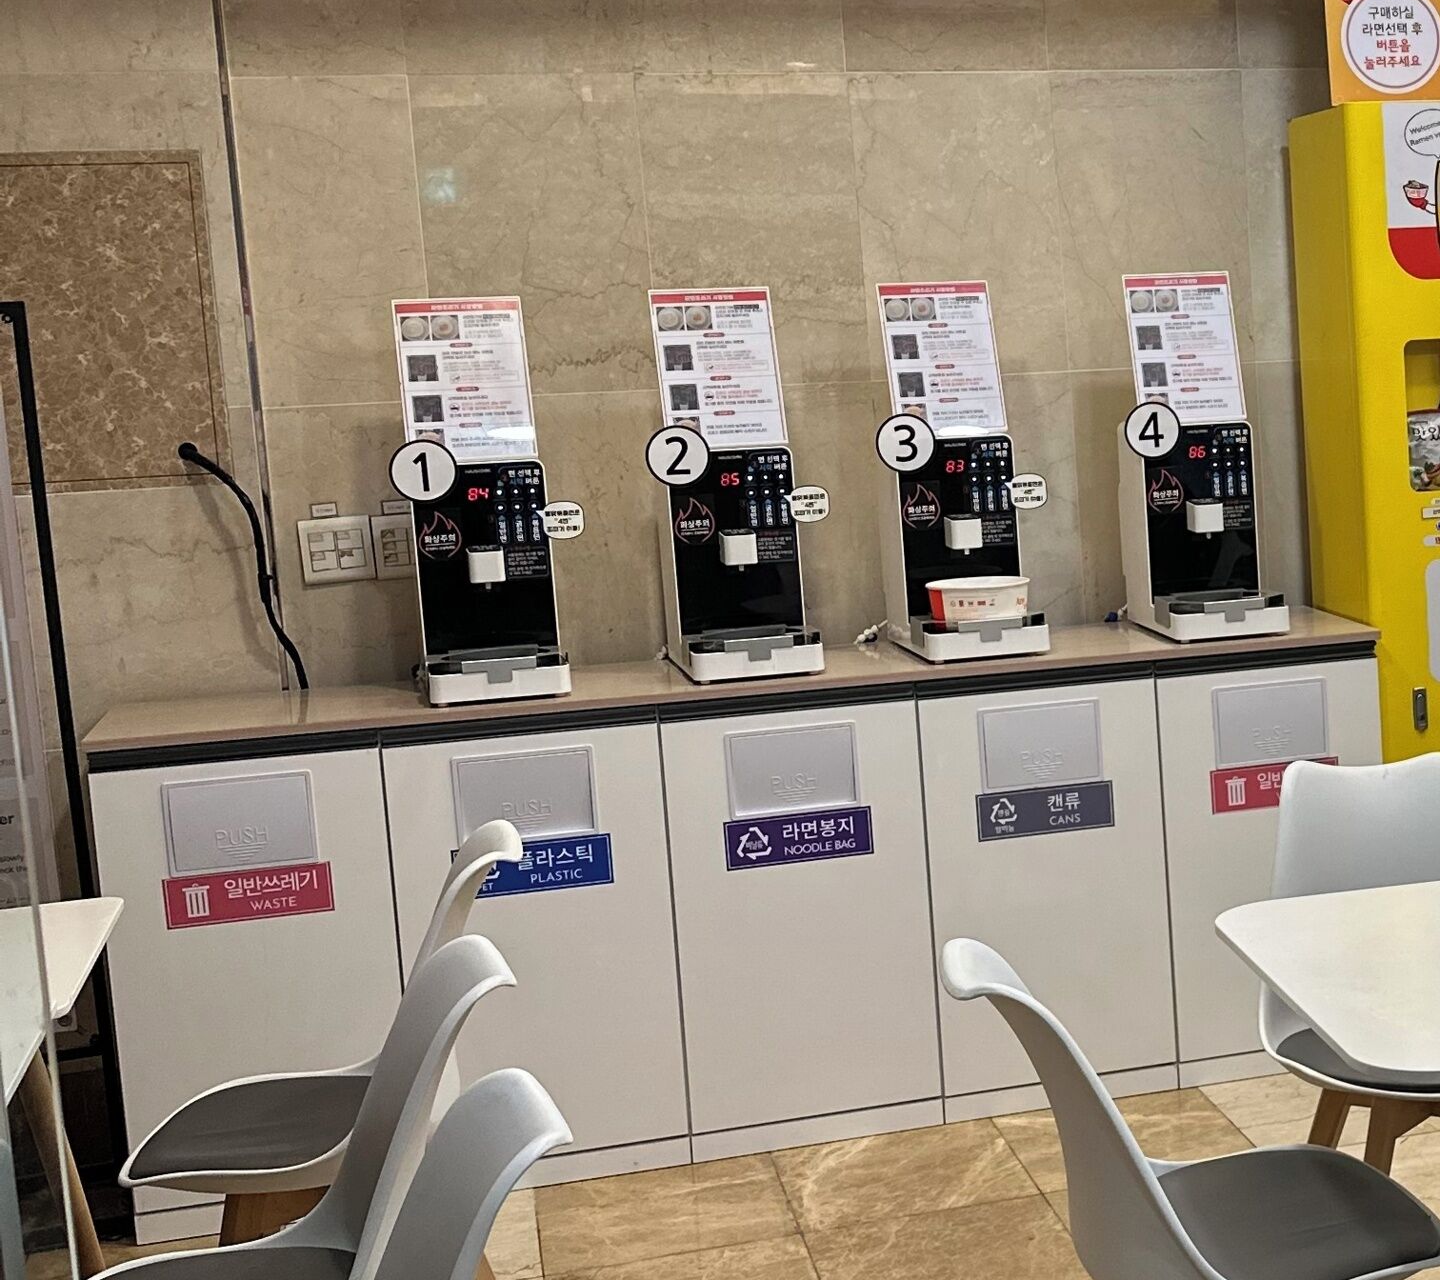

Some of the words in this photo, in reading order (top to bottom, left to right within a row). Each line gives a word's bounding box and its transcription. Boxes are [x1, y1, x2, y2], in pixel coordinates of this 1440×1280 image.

[1368, 6, 1414, 20] 구매하실
[1362, 22, 1408, 36] 라면선택
[1411, 22, 1423, 36] 후
[1376, 39, 1411, 53] 버튼을
[1364, 56, 1422, 70] 눌러주세요
[1138, 412, 1164, 448] 4
[893, 424, 918, 462] 3
[665, 436, 691, 476] 2
[1188, 445, 1207, 459] 86
[412, 452, 430, 492] 1
[945, 459, 965, 473] 83
[720, 472, 740, 487] 85
[467, 487, 489, 501] 84
[1153, 489, 1179, 499] 화상주의
[907, 504, 936, 514] 화상주의
[680, 519, 710, 529] 화상주의
[424, 533, 456, 544] 화상주의
[771, 772, 817, 790] PUSH
[502, 799, 552, 816] PUSH
[1047, 792, 1081, 812] 캔류
[1049, 813, 1081, 826] CANS
[215, 825, 269, 845] PUSH
[782, 816, 854, 841] 라면봉지
[784, 840, 832, 856] NOODLE
[835, 838, 856, 850] BAG
[517, 844, 593, 871] 플라스틱
[530, 868, 583, 884] PLASTIC
[224, 869, 318, 899] 일반쓰레기
[250, 896, 297, 911] WASTE
